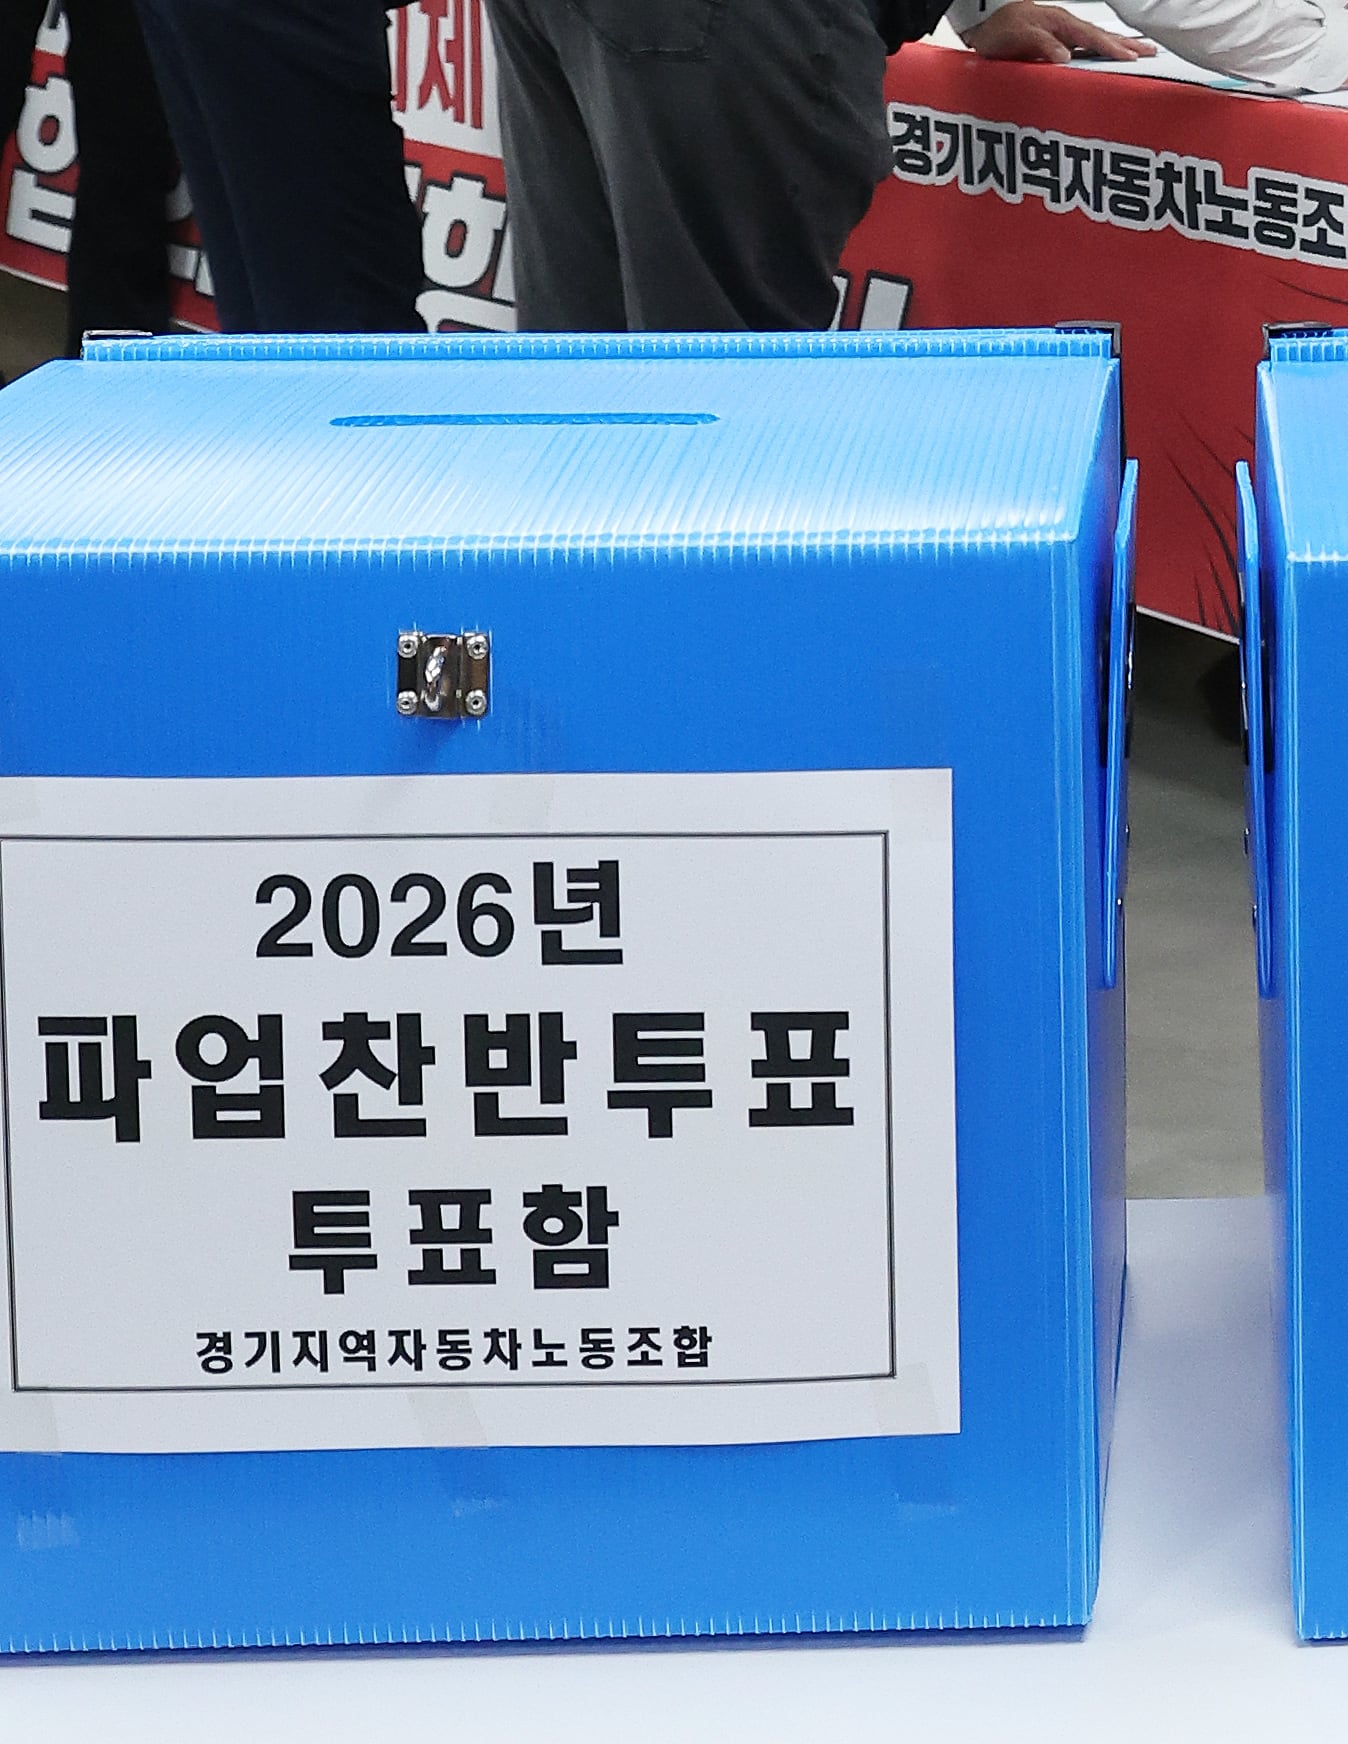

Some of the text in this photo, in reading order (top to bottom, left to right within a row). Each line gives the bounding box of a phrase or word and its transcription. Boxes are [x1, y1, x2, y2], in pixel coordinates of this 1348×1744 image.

[254, 859, 625, 966] 2026년
[288, 1183, 620, 1295] 투표함
[195, 1326, 713, 1375] 경기지역자동차노동조합
